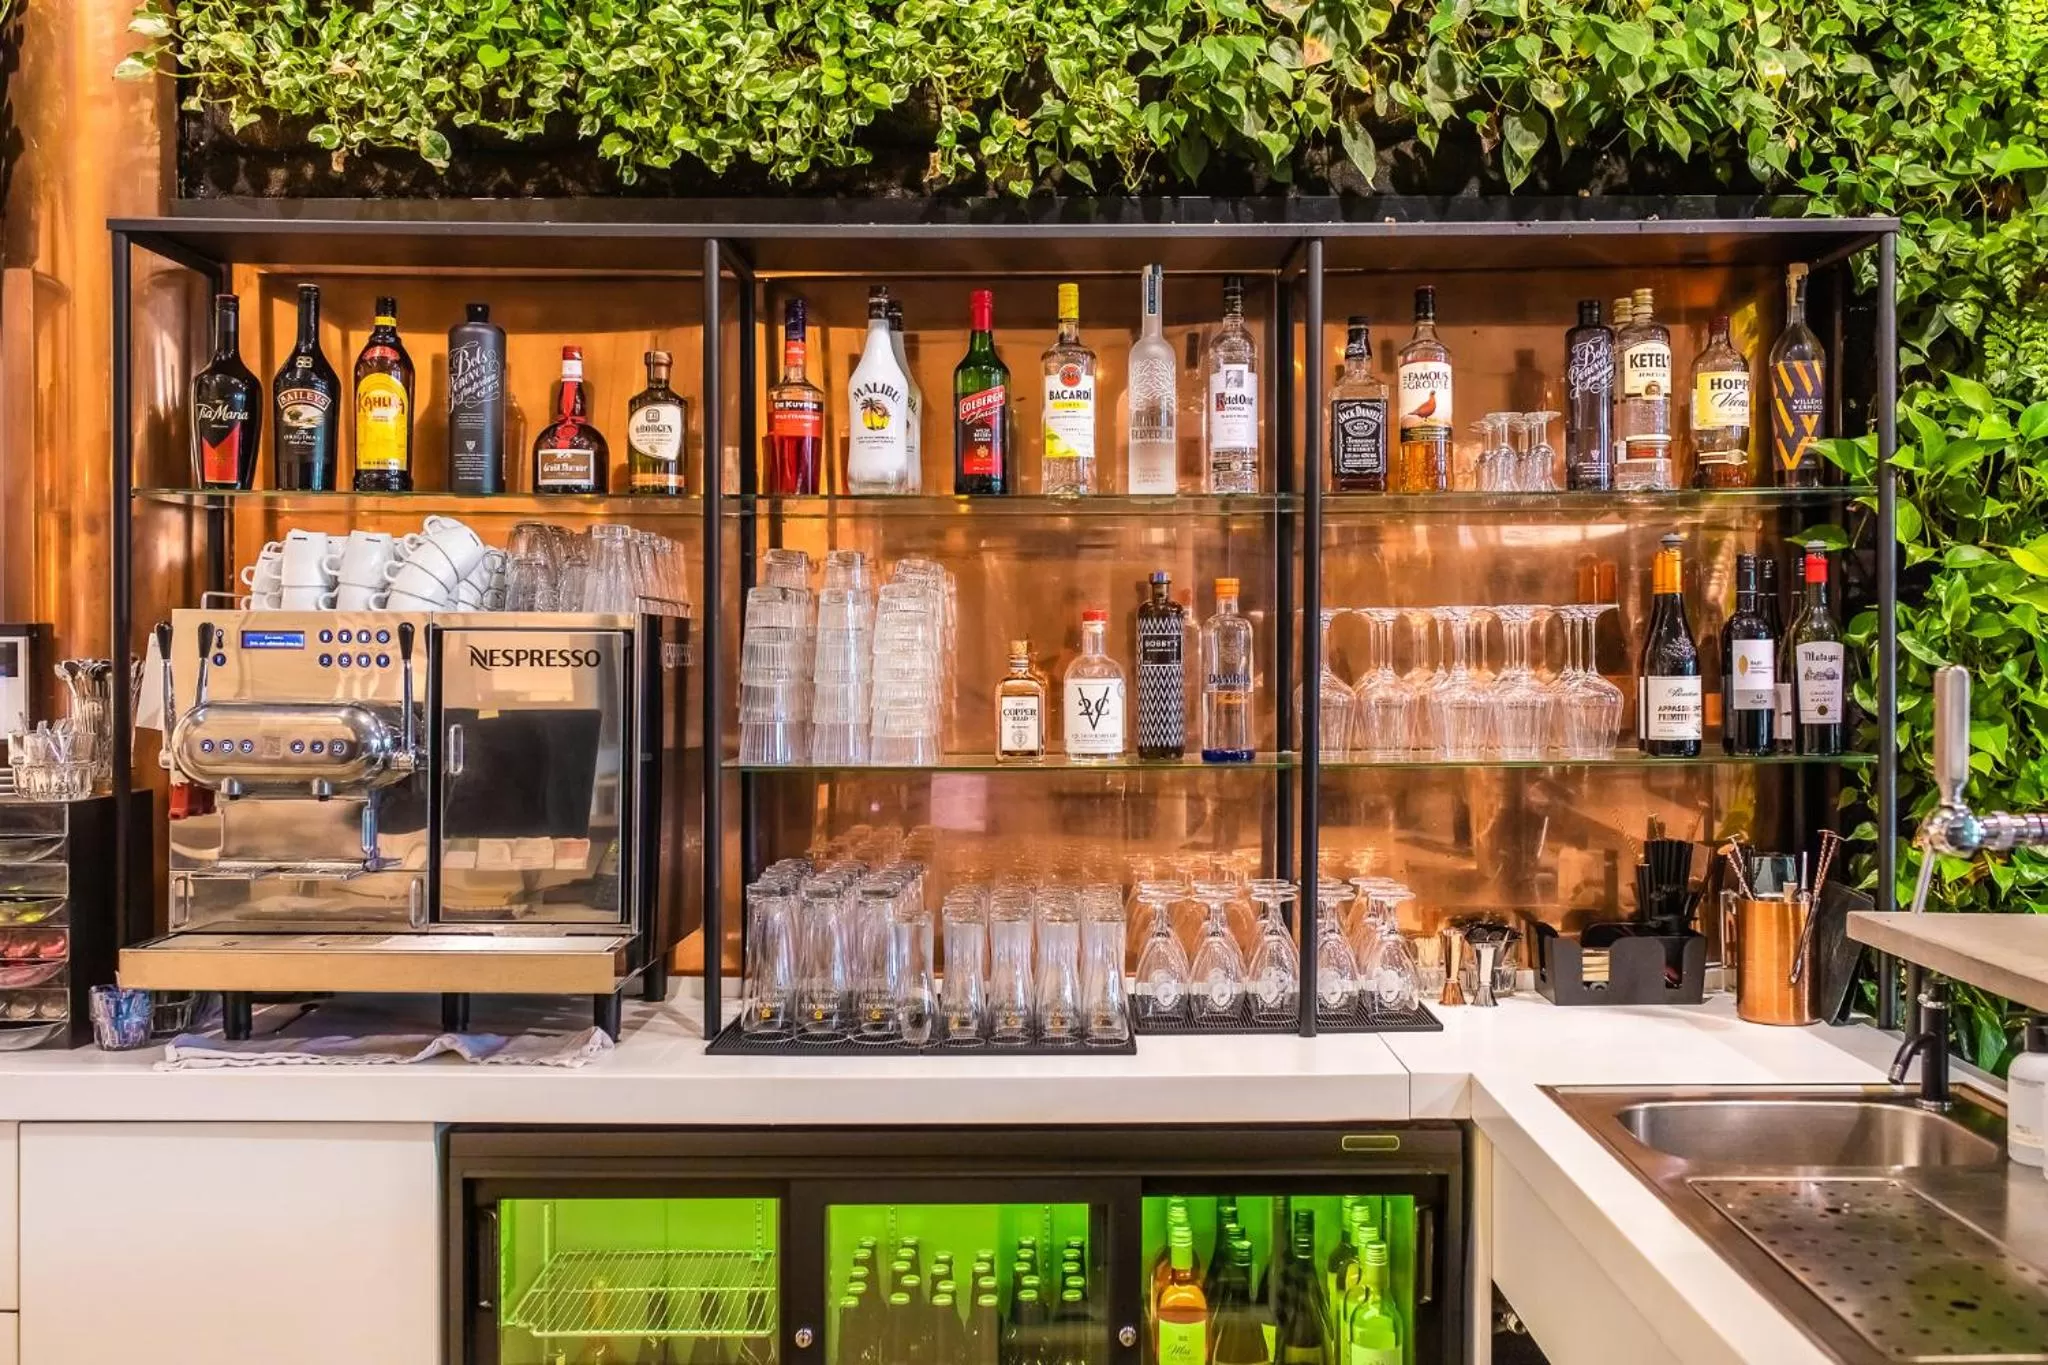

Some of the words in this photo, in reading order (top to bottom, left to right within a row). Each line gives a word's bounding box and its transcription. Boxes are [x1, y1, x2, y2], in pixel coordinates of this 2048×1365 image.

[1629, 353, 1667, 369] KETEL
[1408, 371, 1449, 381] FAMOUS
[280, 391, 327, 406] BAILEYS
[853, 382, 902, 403] MALIBU
[1215, 393, 1238, 411] Ketel
[1239, 394, 1254, 406] One
[210, 404, 249, 421] Maria
[1338, 409, 1356, 424] JACK
[467, 645, 601, 671] NESPRESSO
[1002, 707, 1036, 716] COPPER
